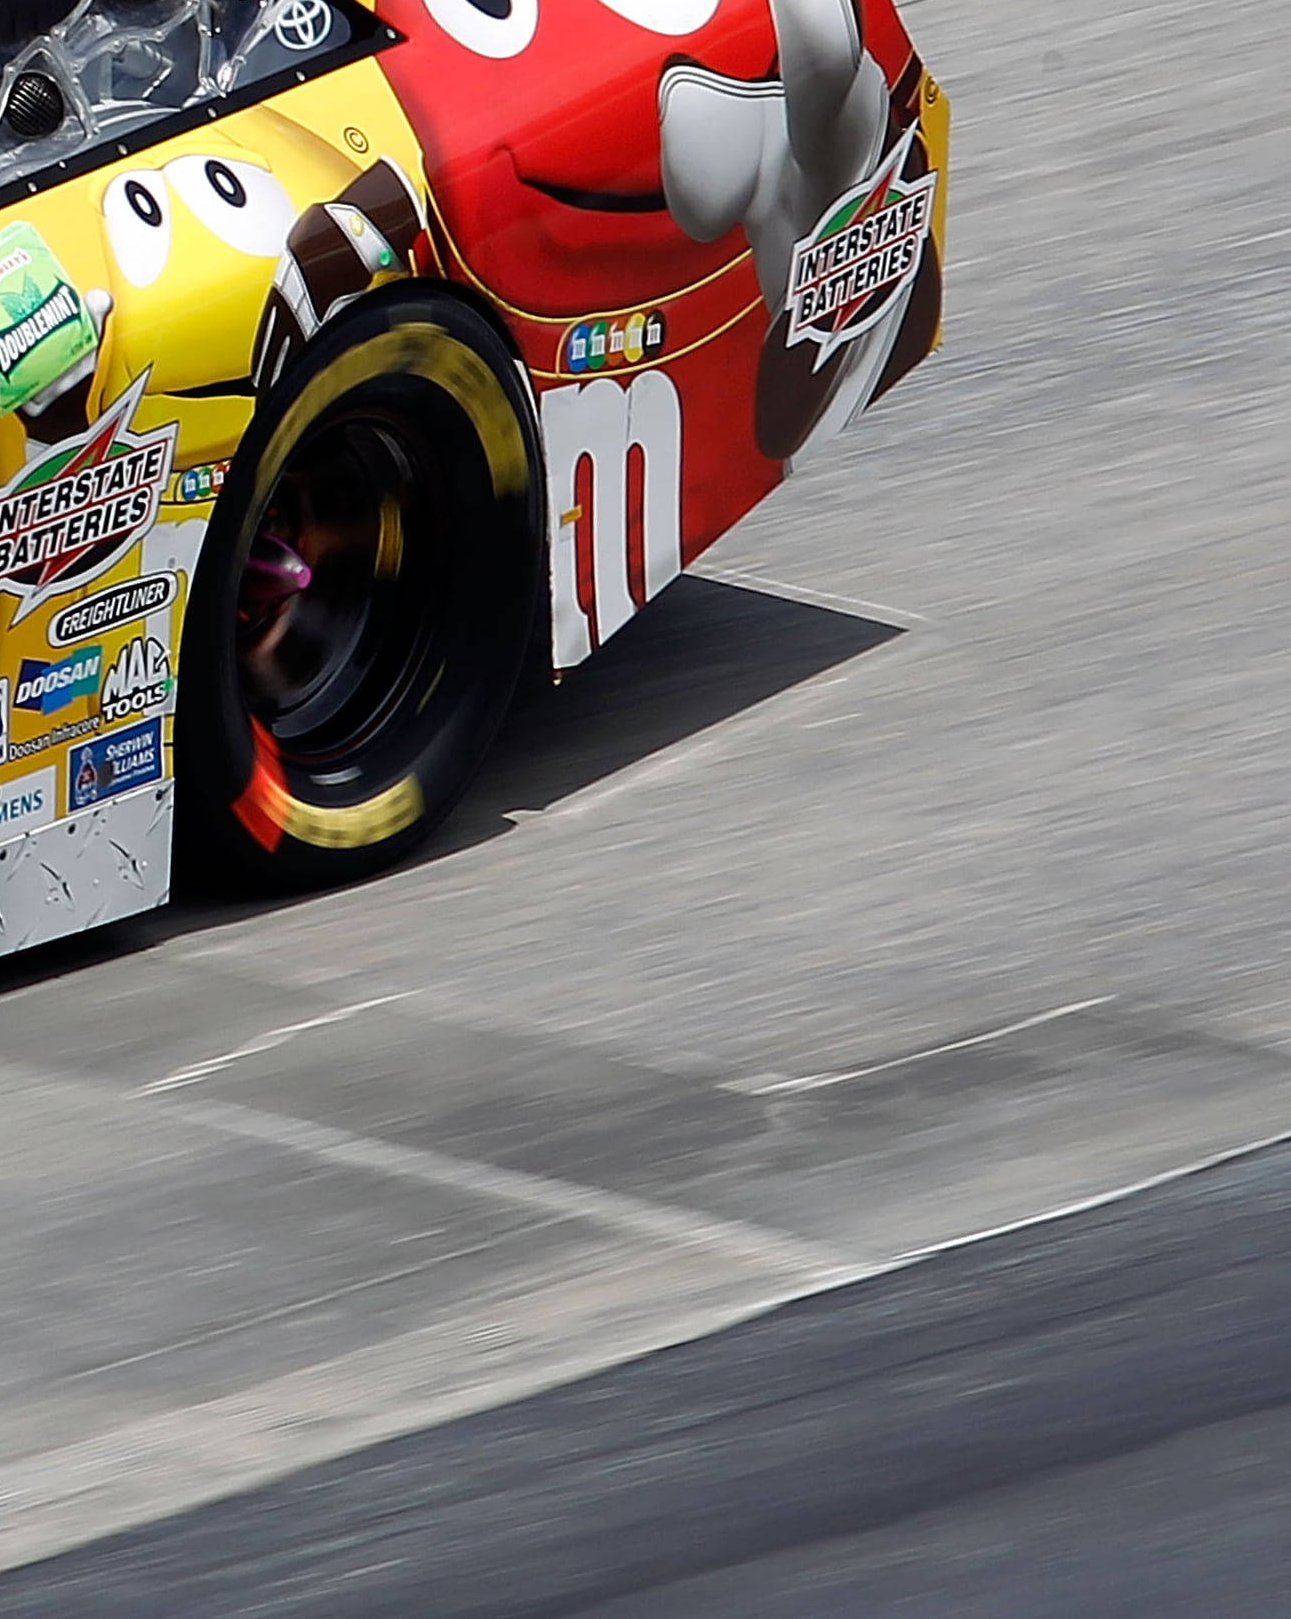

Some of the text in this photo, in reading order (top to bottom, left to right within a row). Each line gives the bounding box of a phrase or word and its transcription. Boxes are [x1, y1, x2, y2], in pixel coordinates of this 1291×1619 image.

[798, 194, 925, 287] INTERSTATE
[801, 237, 915, 322] BATTERIES
[59, 582, 165, 638] FREIGHTLINER
[16, 655, 101, 705] DOOSAN
[102, 682, 167, 722] TOOLS
[8, 716, 102, 761] Doosan Infracore
[105, 731, 154, 762] SHERWIN
